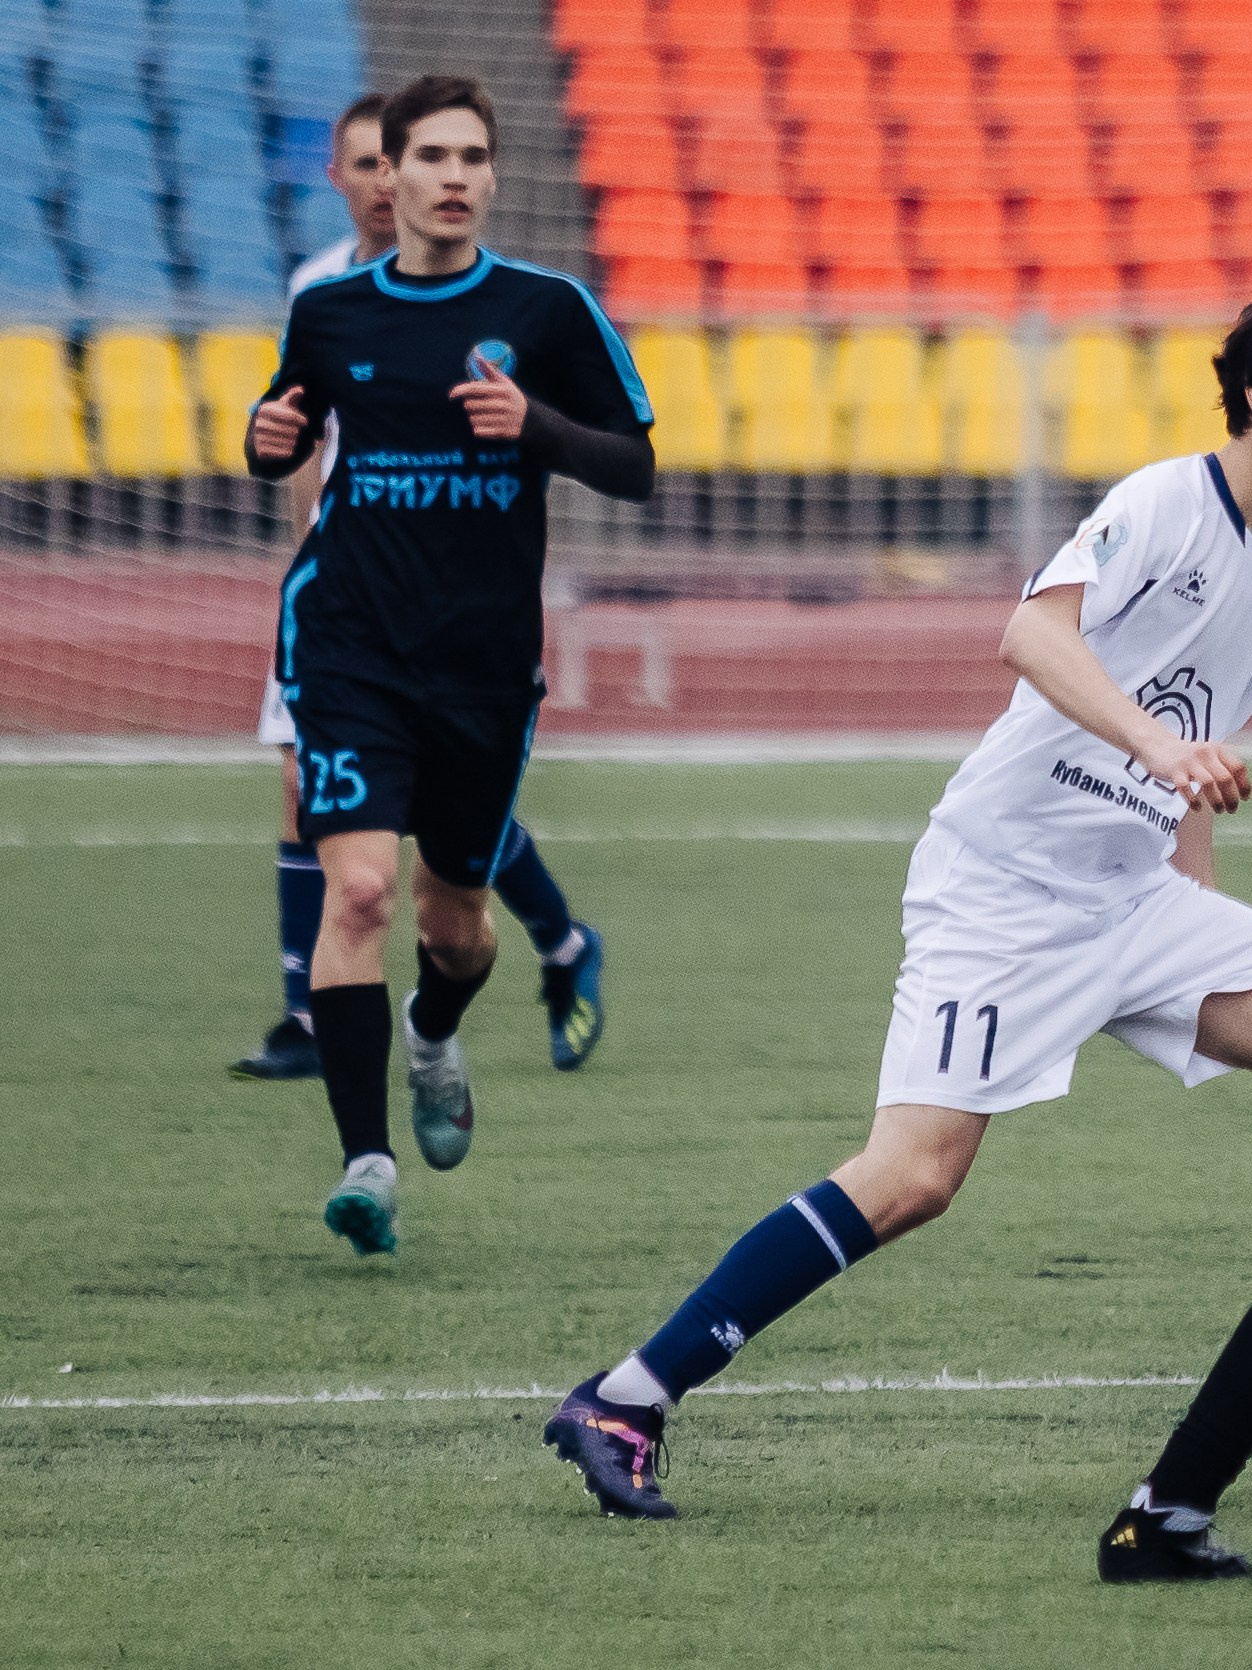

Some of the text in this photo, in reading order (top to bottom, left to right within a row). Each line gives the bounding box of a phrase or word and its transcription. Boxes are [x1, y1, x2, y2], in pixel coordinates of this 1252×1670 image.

[1173, 587, 1205, 607] KELME
[309, 750, 367, 815] 25
[934, 1000, 998, 1081] 11
